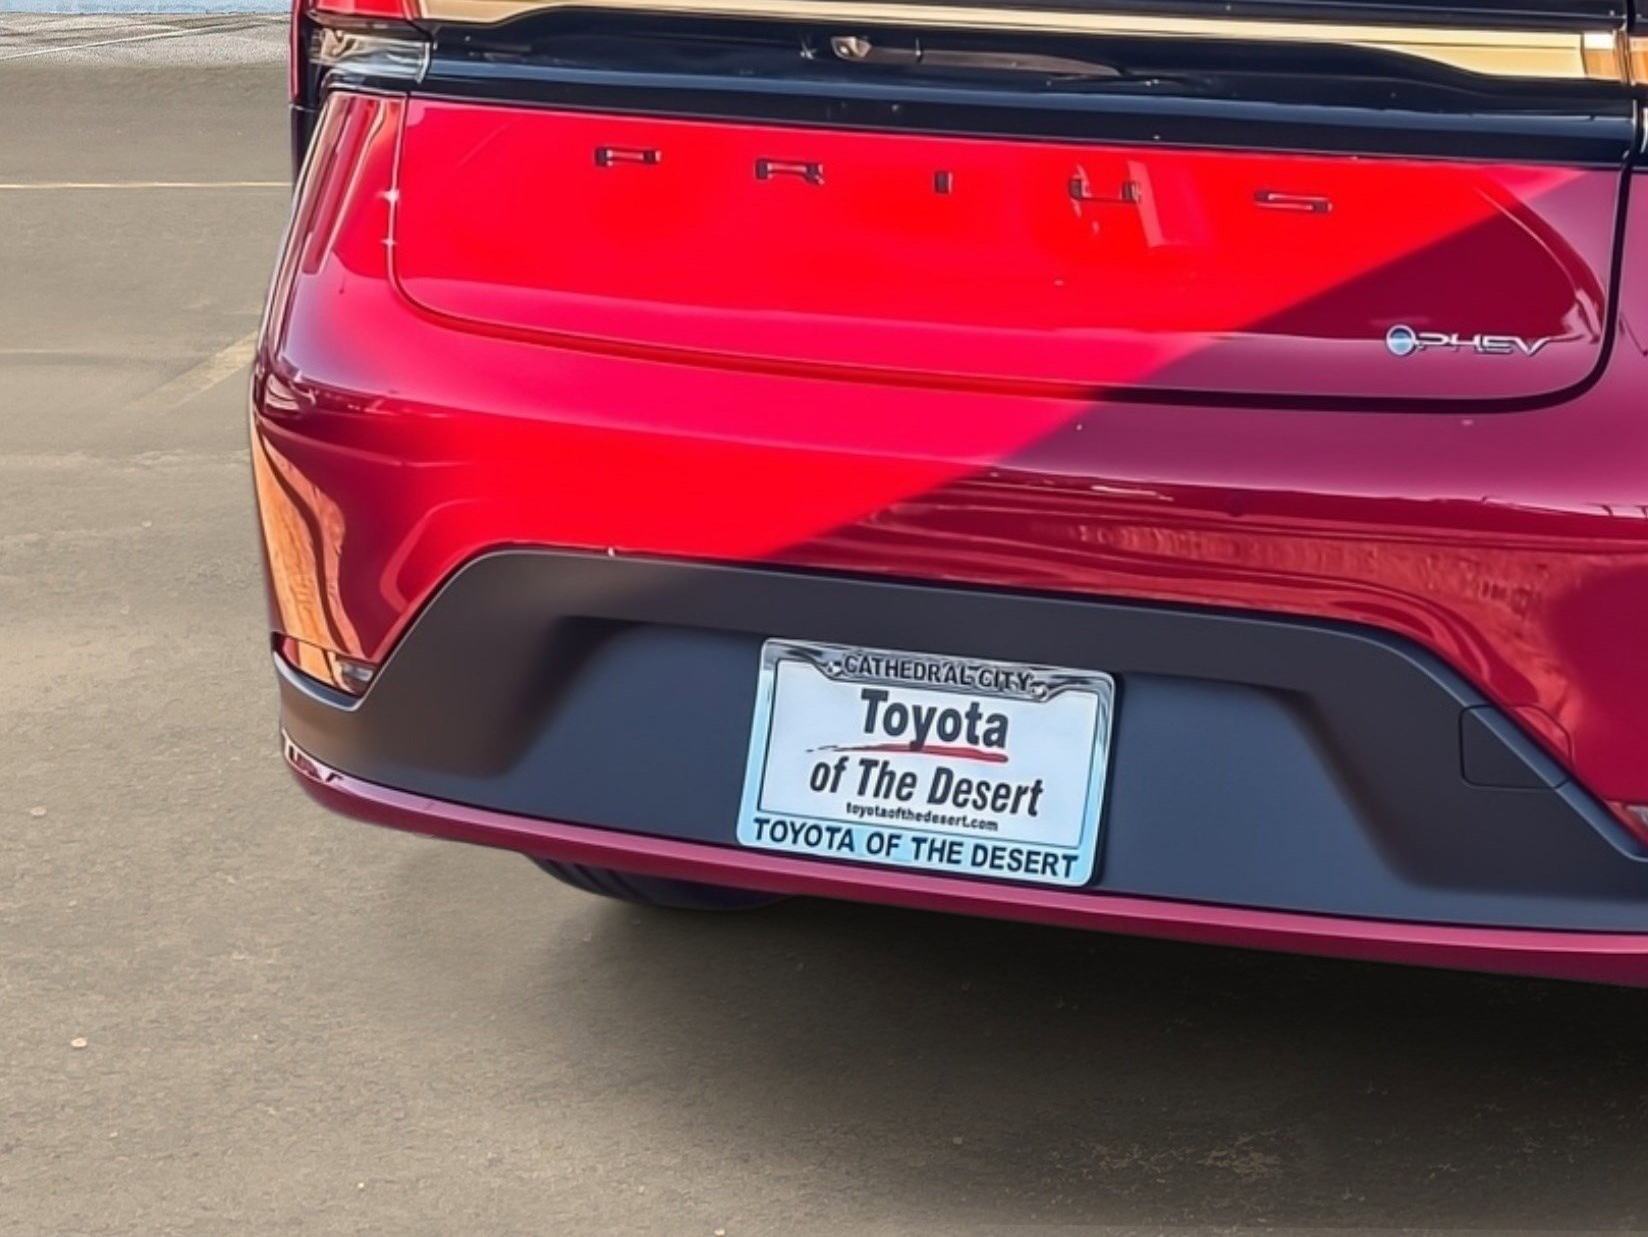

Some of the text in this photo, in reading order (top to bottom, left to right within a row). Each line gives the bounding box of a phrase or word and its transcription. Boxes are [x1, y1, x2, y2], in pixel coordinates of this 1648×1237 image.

[1415, 332, 1552, 356] PHEV
[842, 654, 1032, 692] CATHEDRAL CITY
[860, 688, 1010, 751] Toyota
[809, 756, 1044, 817] of The Desert
[846, 801, 999, 831] toyotaofthedesert.com
[753, 817, 1079, 879] TOYOTA OF THE DESERT
